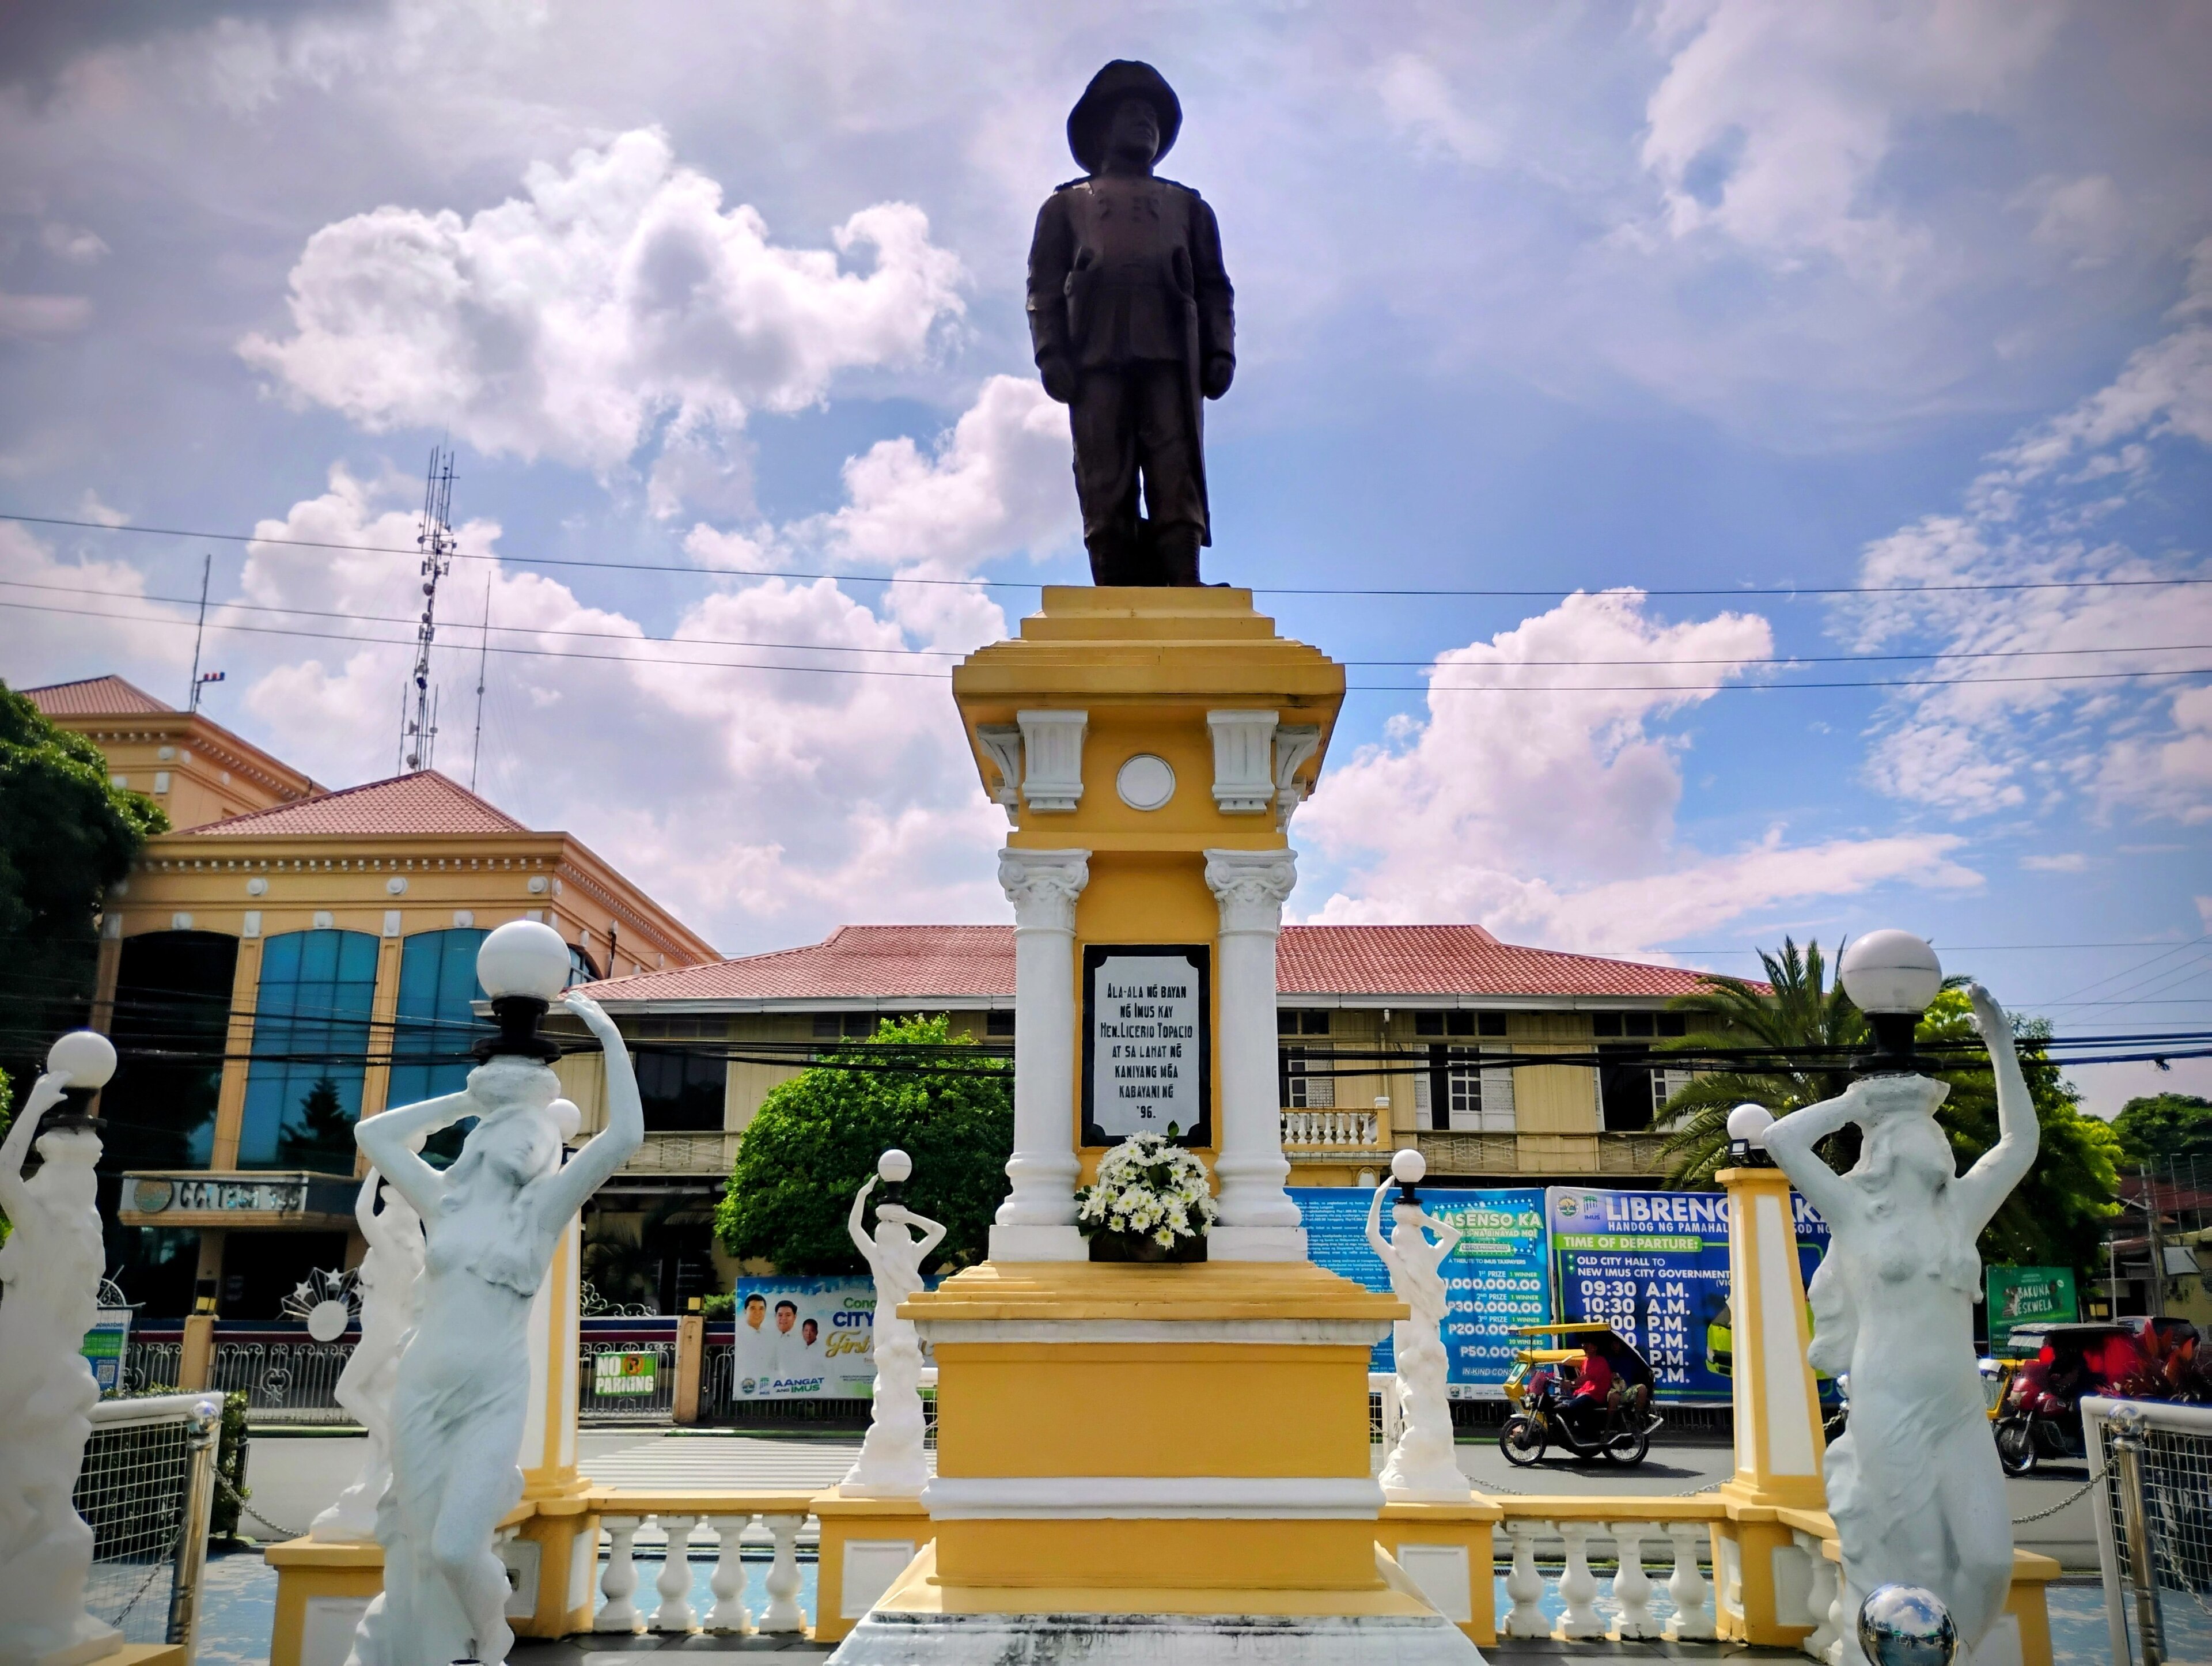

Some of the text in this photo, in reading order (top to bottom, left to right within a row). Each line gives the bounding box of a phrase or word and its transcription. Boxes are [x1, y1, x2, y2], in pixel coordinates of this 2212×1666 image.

[1161, 986, 1186, 998] BAYAN
[1134, 1002, 1154, 1018] IMUS
[1158, 1005, 1173, 1018] KAY
[1158, 1022, 1193, 1038] TOPACIO
[1112, 1046, 1121, 1058] AT
[1125, 1046, 1136, 1058] SA
[1139, 1046, 1167, 1058] LAHAT
[1115, 1065, 1157, 1078] KANIYANG
[1119, 1085, 1160, 1098] KABAYANI
[1518, 1213, 1541, 1226] KA
[1608, 1222, 1653, 1232] HANDOG
[1659, 1222, 1673, 1232] NG
[1475, 1229, 1484, 1237] NA
[1563, 1236, 1698, 1249] TIME OF DEPARTURE:
[1577, 1256, 1665, 1266] OLD CITY HALL TO
[1578, 1268, 1730, 1278] NEW IMUS CITY GOVERNMENT
[1581, 1281, 1690, 1297] 09:30 A.M.
[2017, 1284, 2050, 1299] BAKUNA
[1582, 1297, 1691, 1315] 10:30 A.M.
[2018, 1299, 2052, 1314] ESKWELA
[833, 1311, 874, 1327] CITY
[1647, 1316, 1688, 1332] P.M.
[825, 1331, 870, 1358] First
[1648, 1333, 1689, 1349] P.M.
[597, 1355, 621, 1376] NO
[1649, 1350, 1690, 1366] P.M.
[1653, 1368, 1690, 1383] P.M.
[596, 1376, 654, 1394] PARKING
[791, 1384, 820, 1393] IMUS
